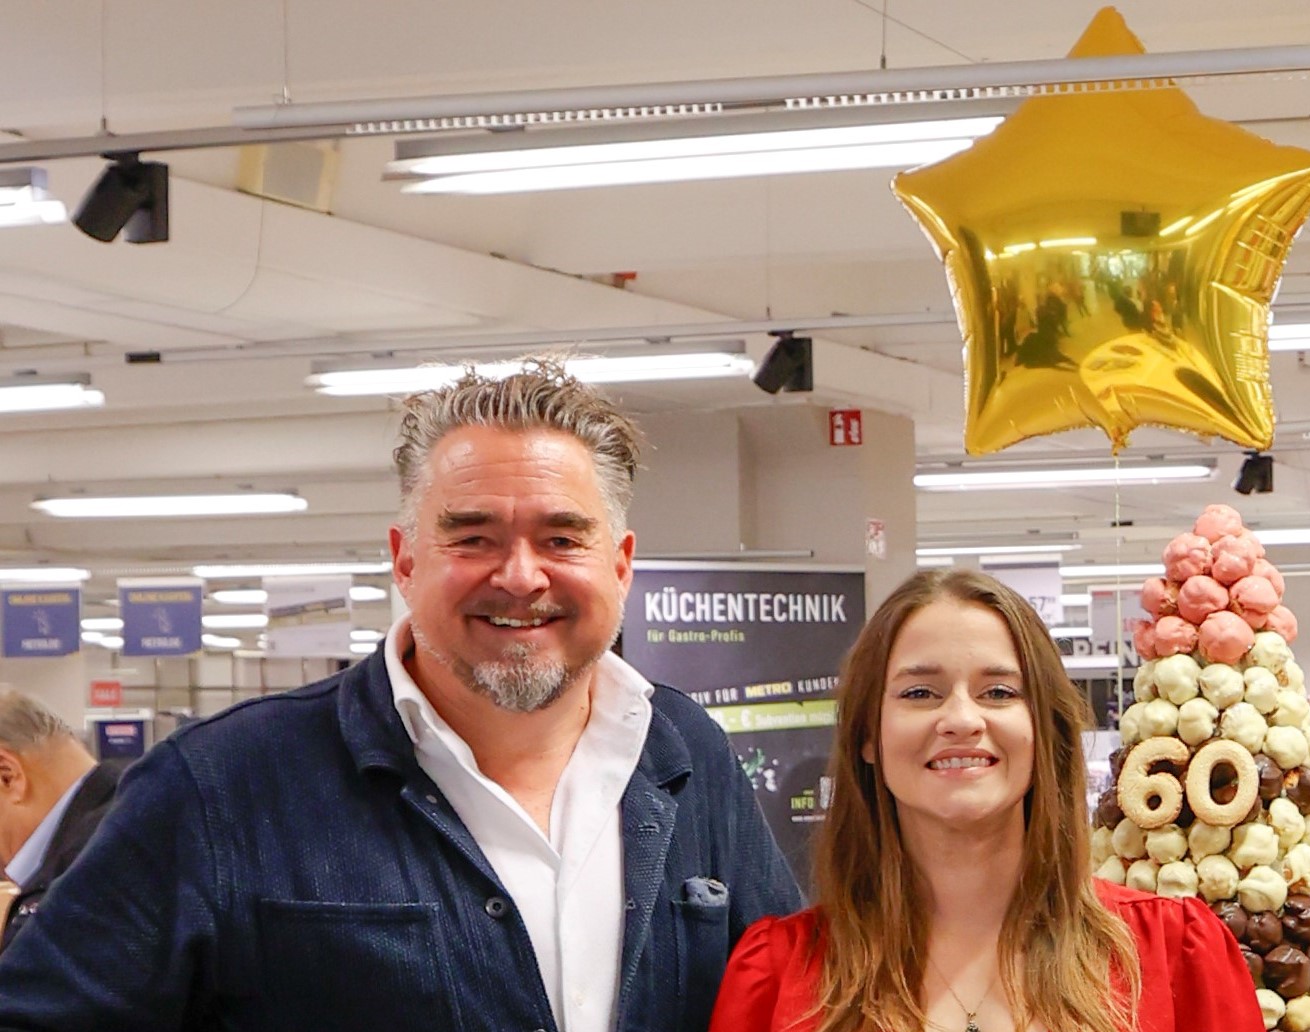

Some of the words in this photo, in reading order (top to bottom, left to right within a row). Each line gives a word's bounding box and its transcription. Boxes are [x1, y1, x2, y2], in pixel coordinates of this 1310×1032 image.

[645, 587, 847, 623] KÜCHENTECHNIK
[647, 629, 664, 643] für
[668, 629, 745, 643] Gastro-Profis
[744, 681, 793, 699] METRO
[1117, 736, 1260, 829] 60
